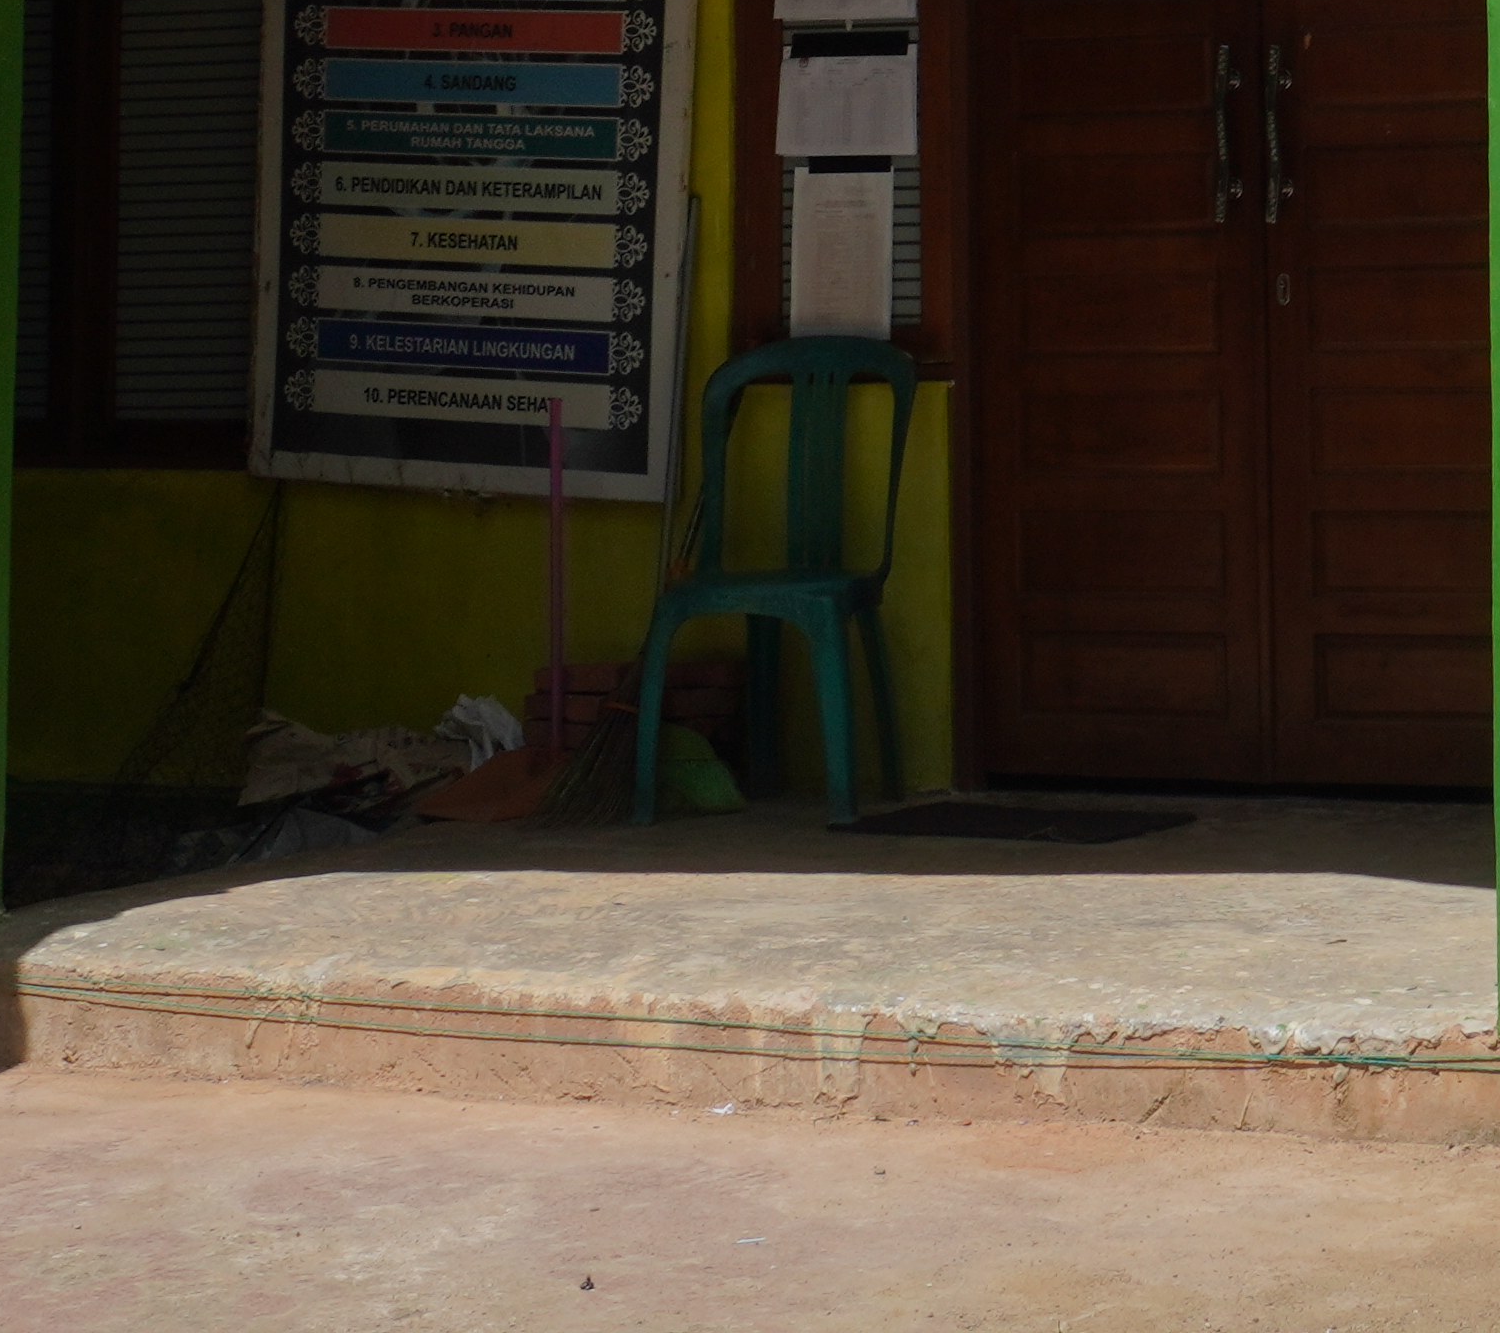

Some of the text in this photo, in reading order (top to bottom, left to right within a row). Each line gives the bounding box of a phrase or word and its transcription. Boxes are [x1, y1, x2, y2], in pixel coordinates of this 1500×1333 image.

[424, 76, 516, 92] 4. SANDANG
[336, 177, 602, 201] 6. PENDIDIKAN DAN KETERAMPILAN
[411, 232, 518, 250] 7. KESEHATAN
[349, 335, 575, 361] 9. KELESTARIAN LINGKUNGAN
